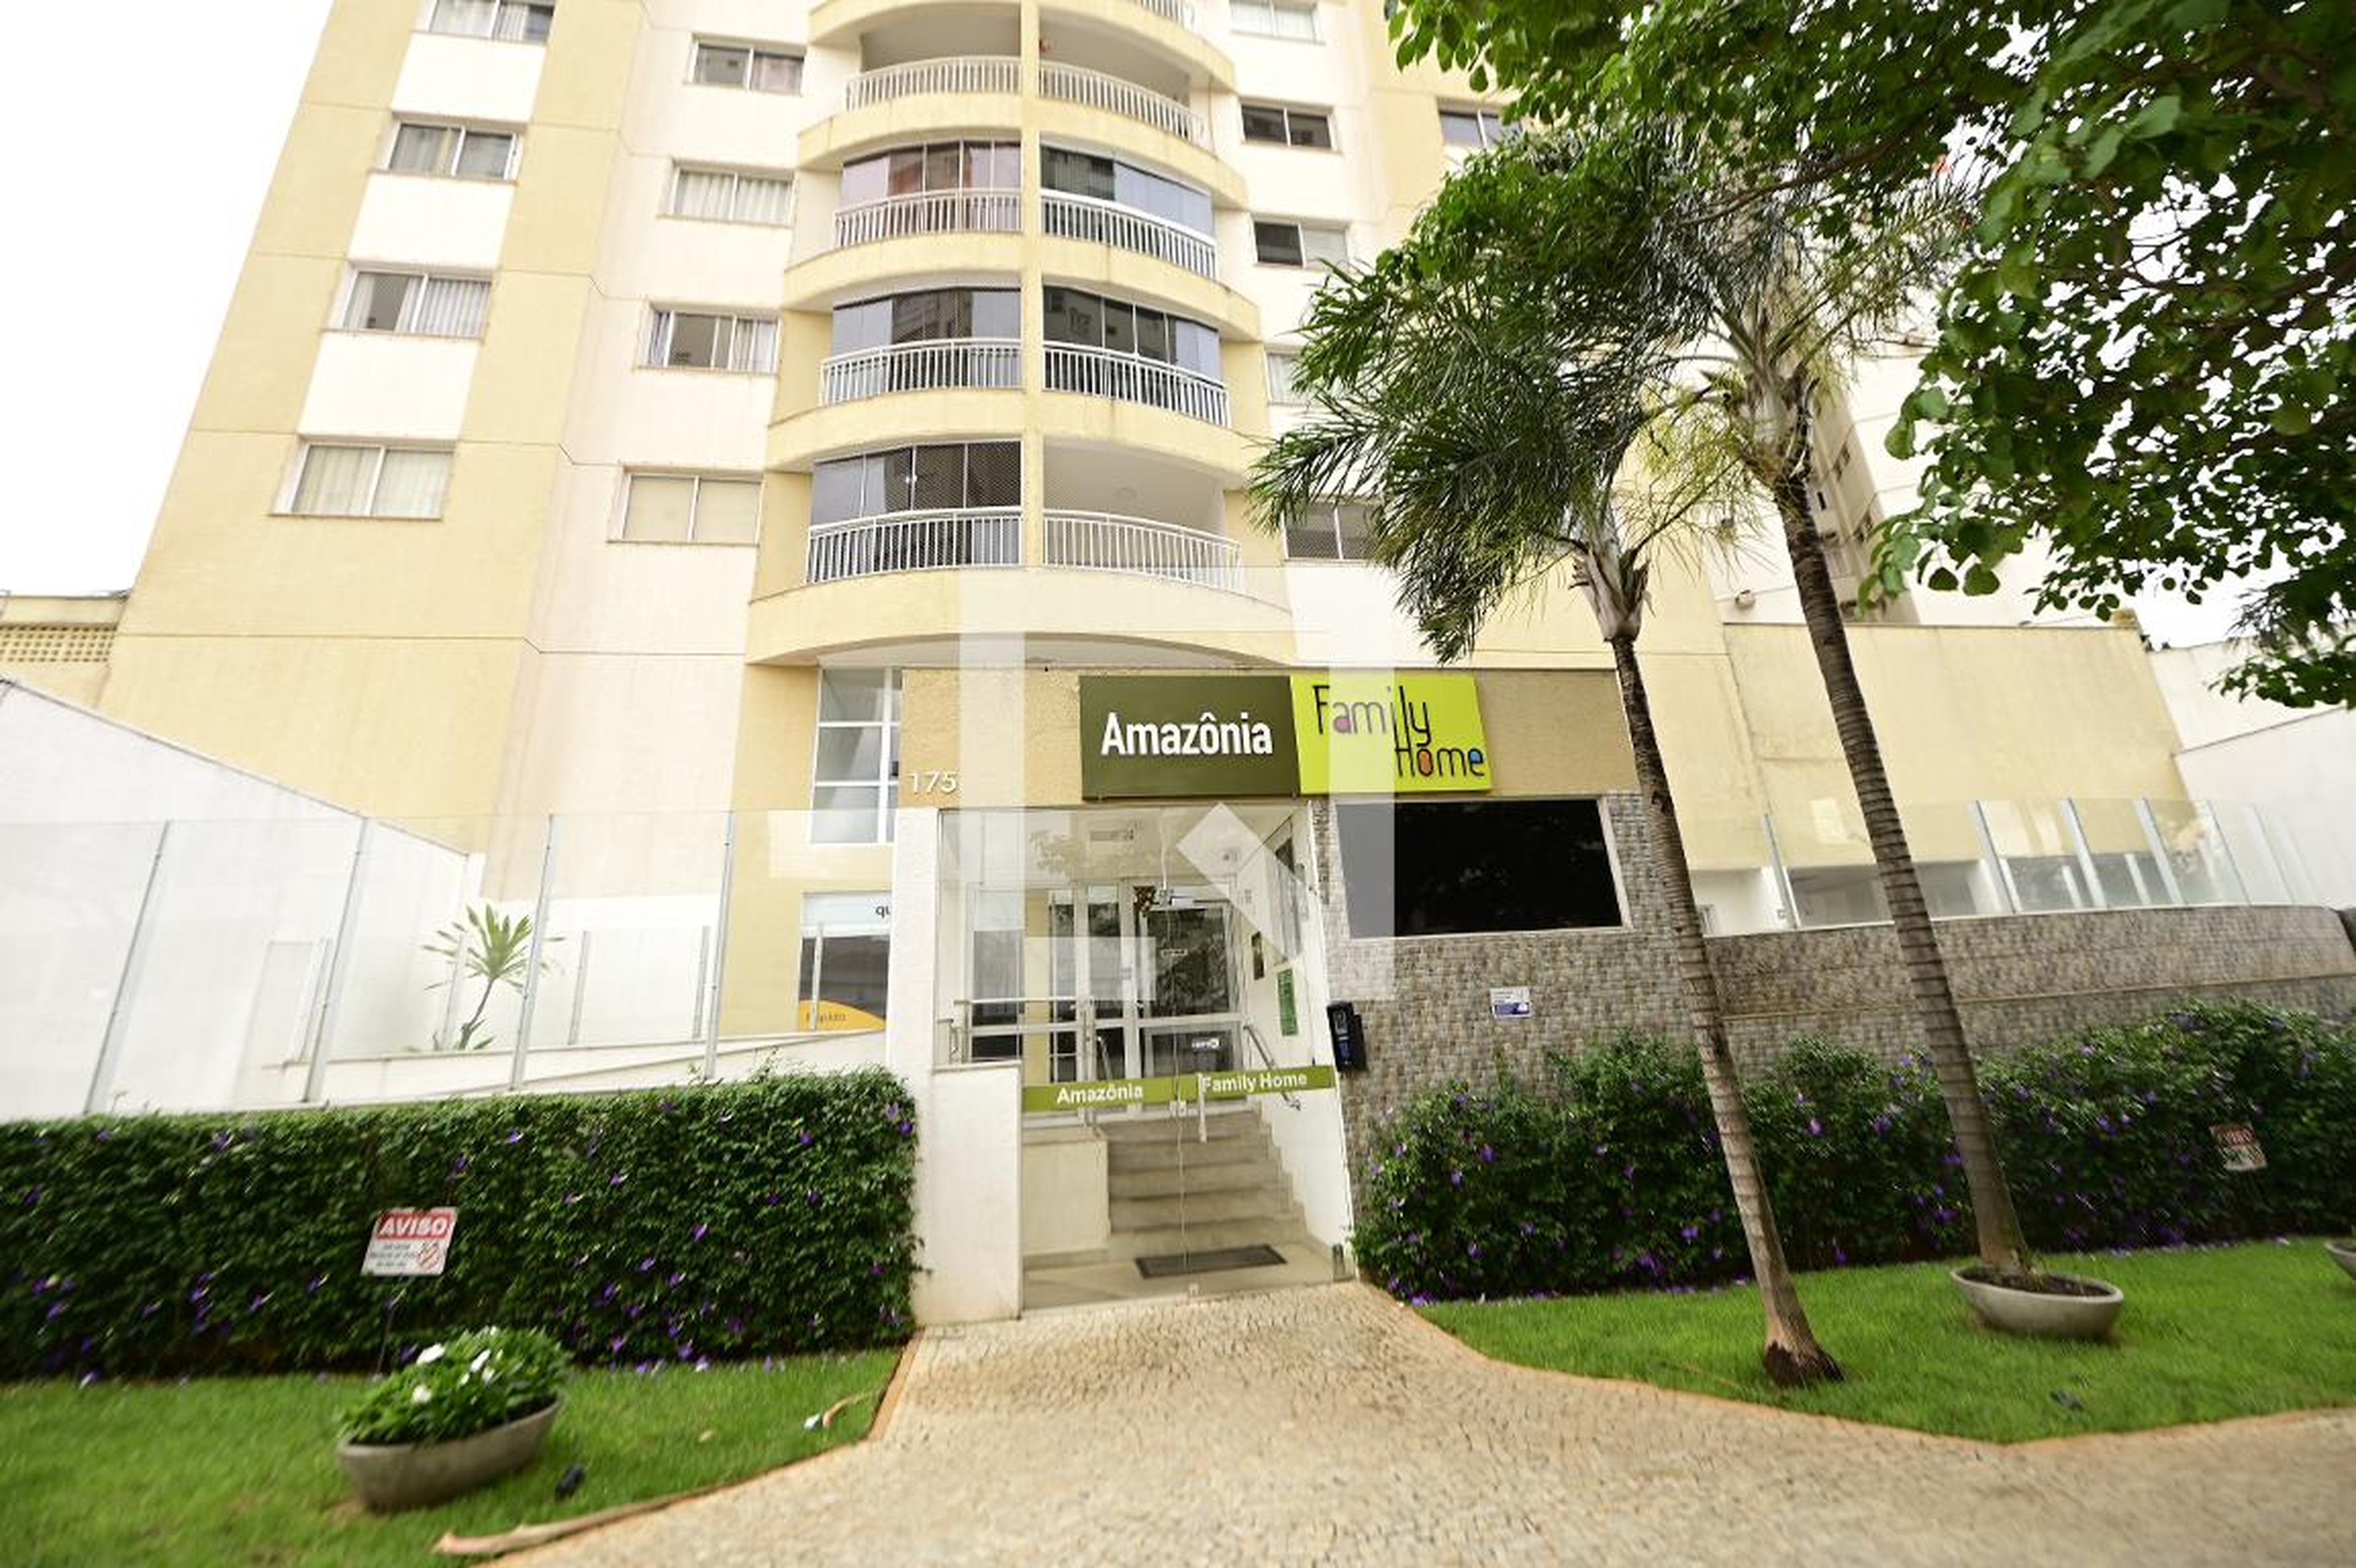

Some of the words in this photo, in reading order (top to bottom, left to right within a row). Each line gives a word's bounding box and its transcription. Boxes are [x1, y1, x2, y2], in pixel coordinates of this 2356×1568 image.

[1312, 685, 1432, 747] Family
[1101, 711, 1273, 756] Amazônia
[1395, 747, 1485, 777] Home
[907, 771, 957, 793] 175
[1057, 1083, 1144, 1104] Amazônia
[1202, 1074, 1257, 1093] Family
[1260, 1072, 1307, 1090] Home
[378, 1216, 449, 1237] AVISO
